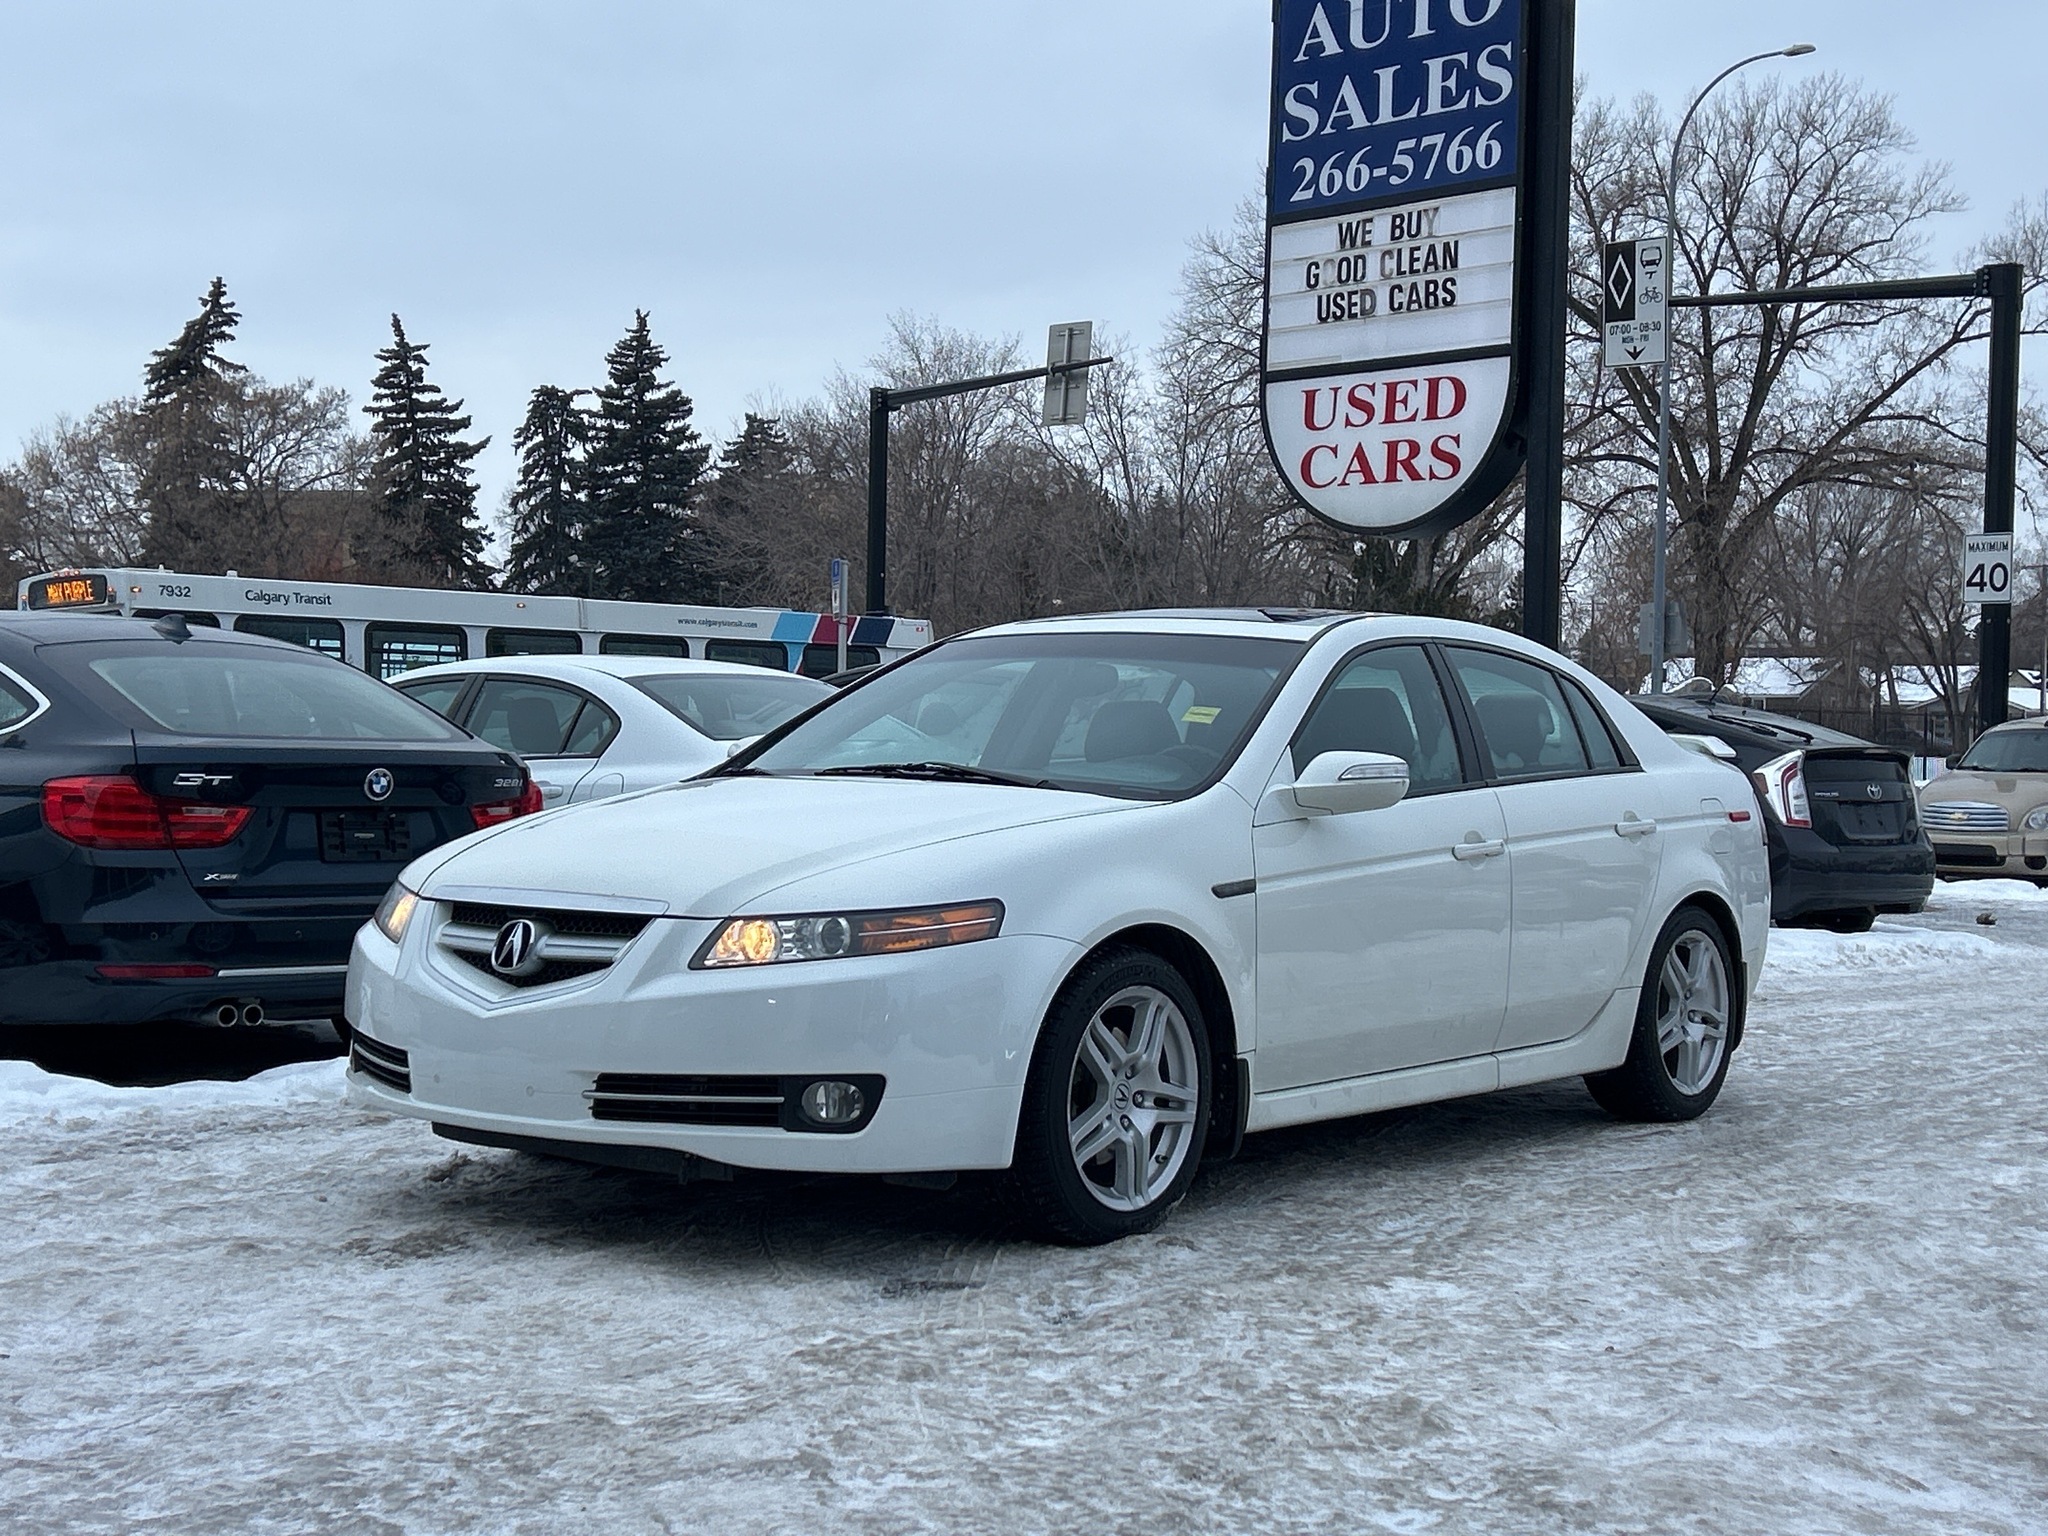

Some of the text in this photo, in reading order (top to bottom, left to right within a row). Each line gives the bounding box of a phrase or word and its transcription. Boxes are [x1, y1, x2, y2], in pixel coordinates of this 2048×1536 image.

[1282, 41, 1514, 143] SALES
[1289, 120, 1503, 202] 266-5766
[1338, 206, 1440, 249] WE BUY
[1306, 240, 1459, 289] GOOD CLEAN
[1317, 277, 1457, 322] USED CARS
[1301, 376, 1467, 431] USED
[1300, 433, 1461, 489] CARS
[1968, 541, 2009, 552] MAXIMUM
[158, 585, 191, 598] 7932
[245, 589, 332, 606] Calgary Transit
[1966, 562, 2009, 592] 40
